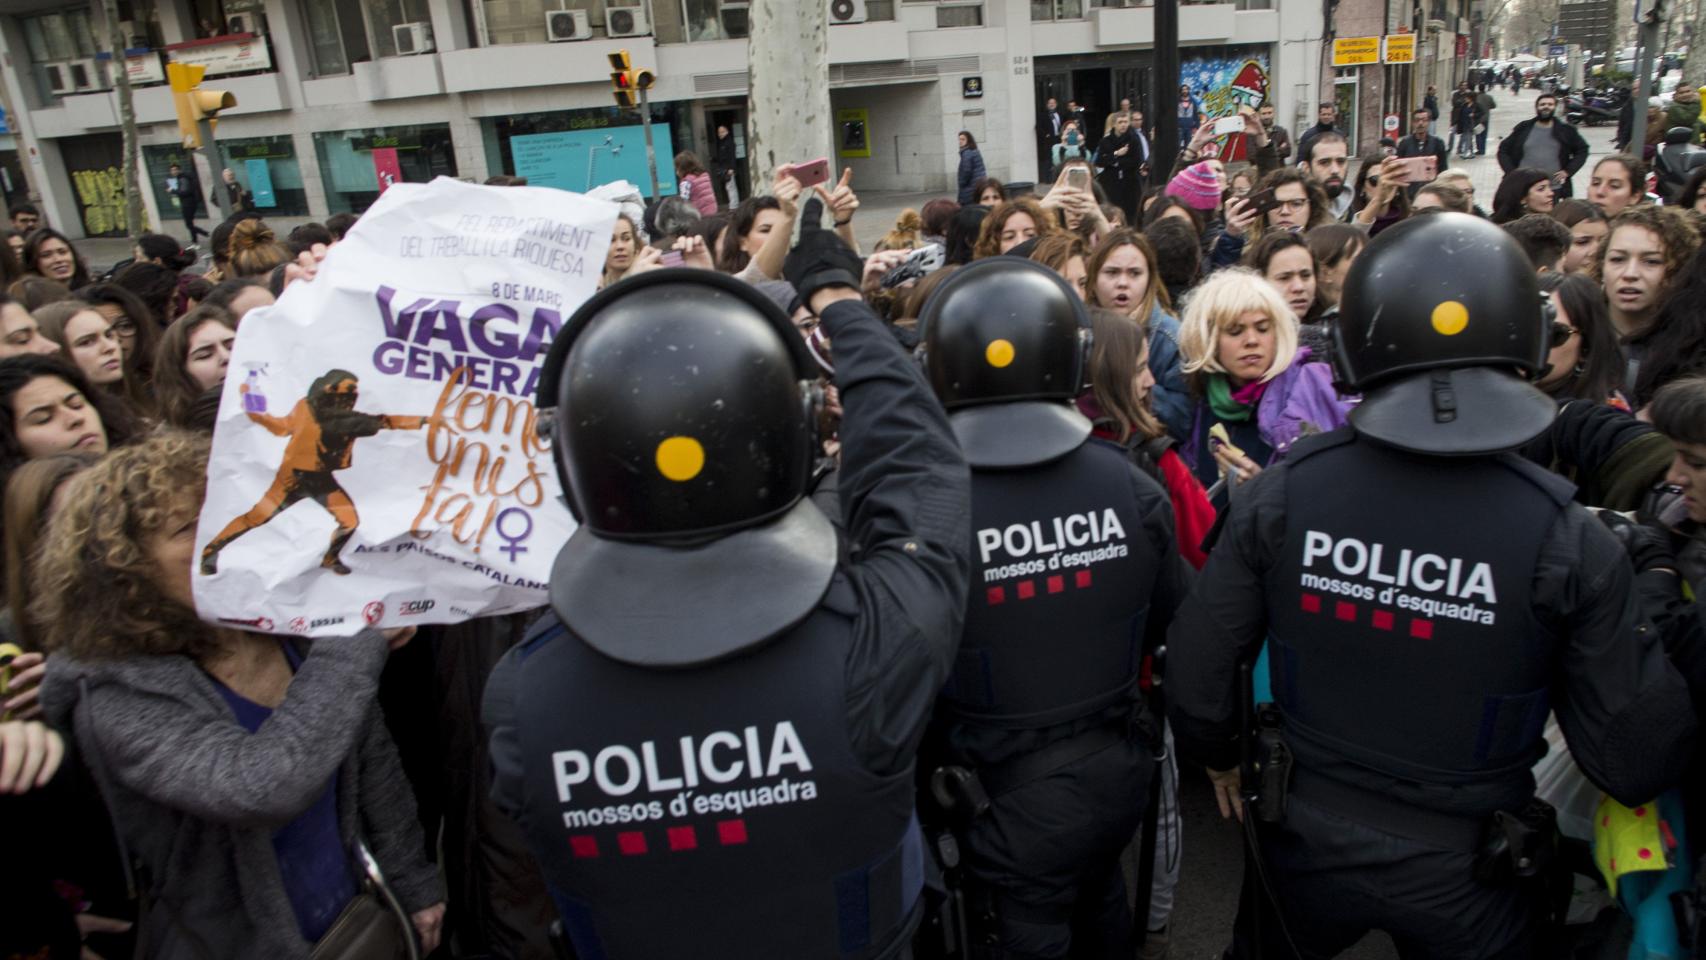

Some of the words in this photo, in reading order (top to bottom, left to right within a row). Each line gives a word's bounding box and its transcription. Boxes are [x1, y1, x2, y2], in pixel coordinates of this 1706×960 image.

[401, 236, 424, 258] DEL
[513, 238, 584, 277] RIQUESA
[492, 282, 500, 299] 8
[504, 283, 522, 301] DE
[376, 285, 563, 361] VAGA
[977, 508, 1126, 564] POLICIA
[462, 560, 550, 592] CATALANS
[984, 558, 1046, 583] mossos
[1302, 530, 1497, 603] POLICIA
[1301, 573, 1375, 600] mossos
[552, 720, 813, 802] POLICIA
[563, 801, 664, 828] mossos
